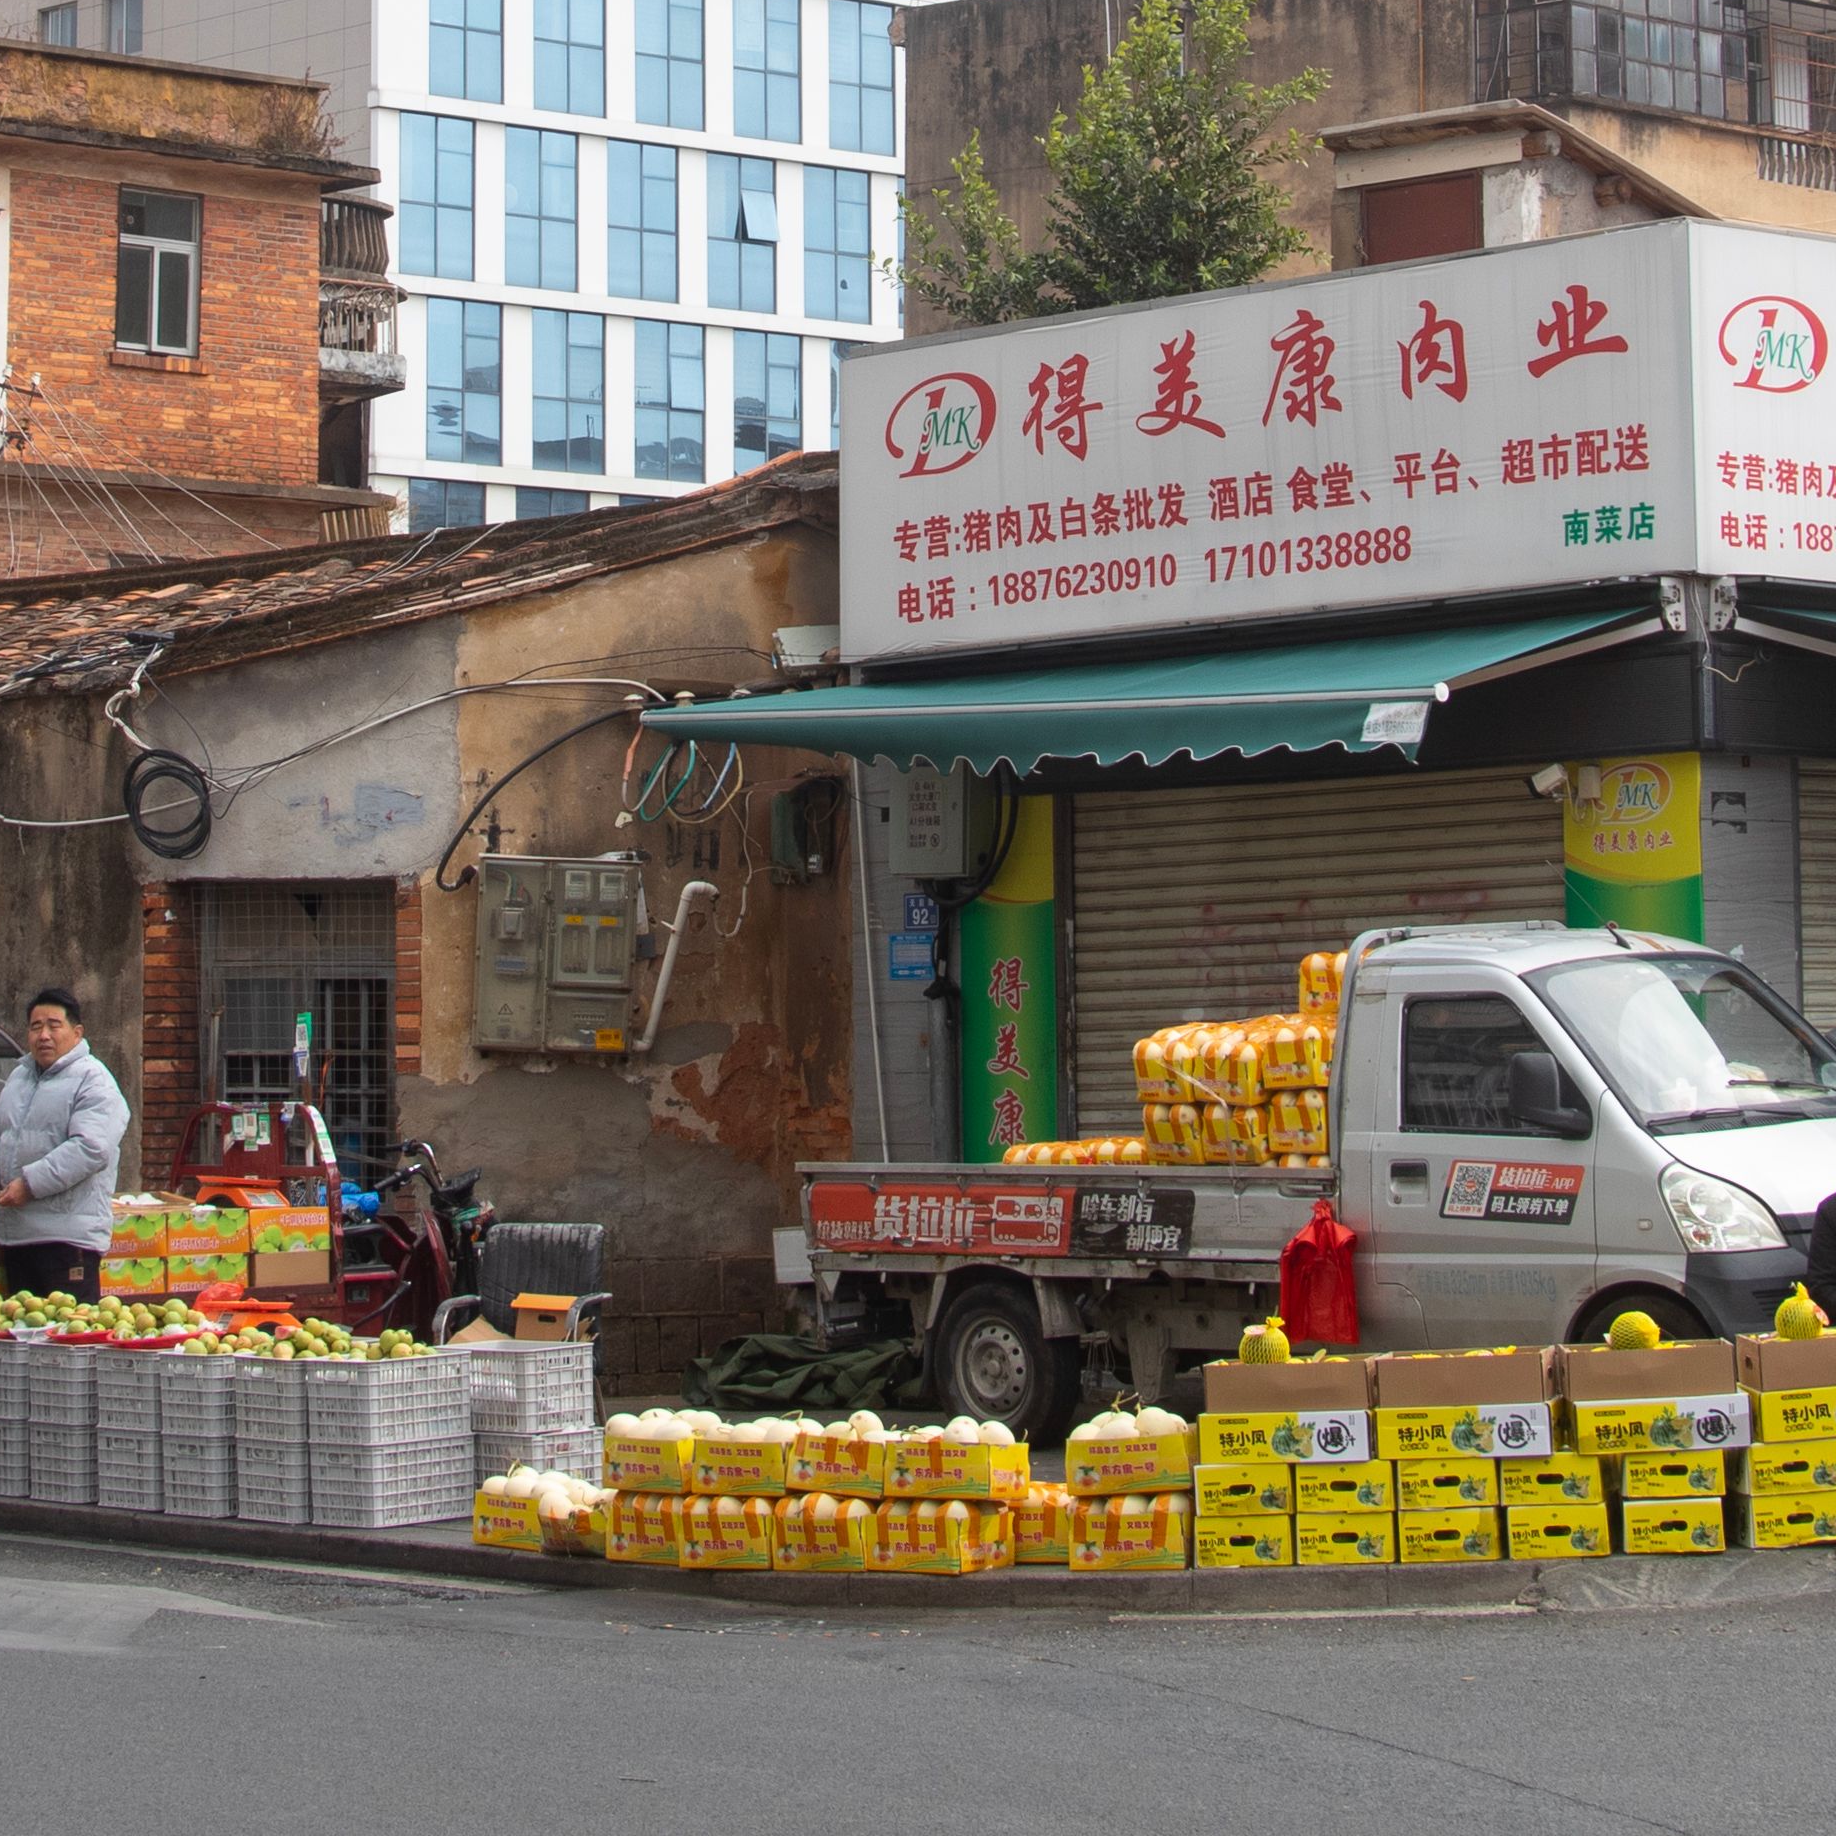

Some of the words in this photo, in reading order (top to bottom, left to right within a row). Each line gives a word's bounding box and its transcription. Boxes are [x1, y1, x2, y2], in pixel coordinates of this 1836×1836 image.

[1022, 284, 1630, 462] 得美康肉业
[1562, 502, 1655, 547] 南菜店
[1203, 526, 1413, 586] 17101338888
[1593, 828, 1674, 853] 得美康肉业
[987, 956, 1030, 1147] 得美康
[1498, 1167, 1552, 1189] 货拉拉
[1551, 1177, 1575, 1189] APP
[874, 1195, 976, 1246] 货拉拉
[1126, 1225, 1182, 1252] 都便宜
[1782, 1404, 1831, 1423] 特小凤
[1219, 1429, 1267, 1450] 特小凤
[1398, 1425, 1447, 1441] 特小凤
[1595, 1421, 1645, 1439] 特小凤
